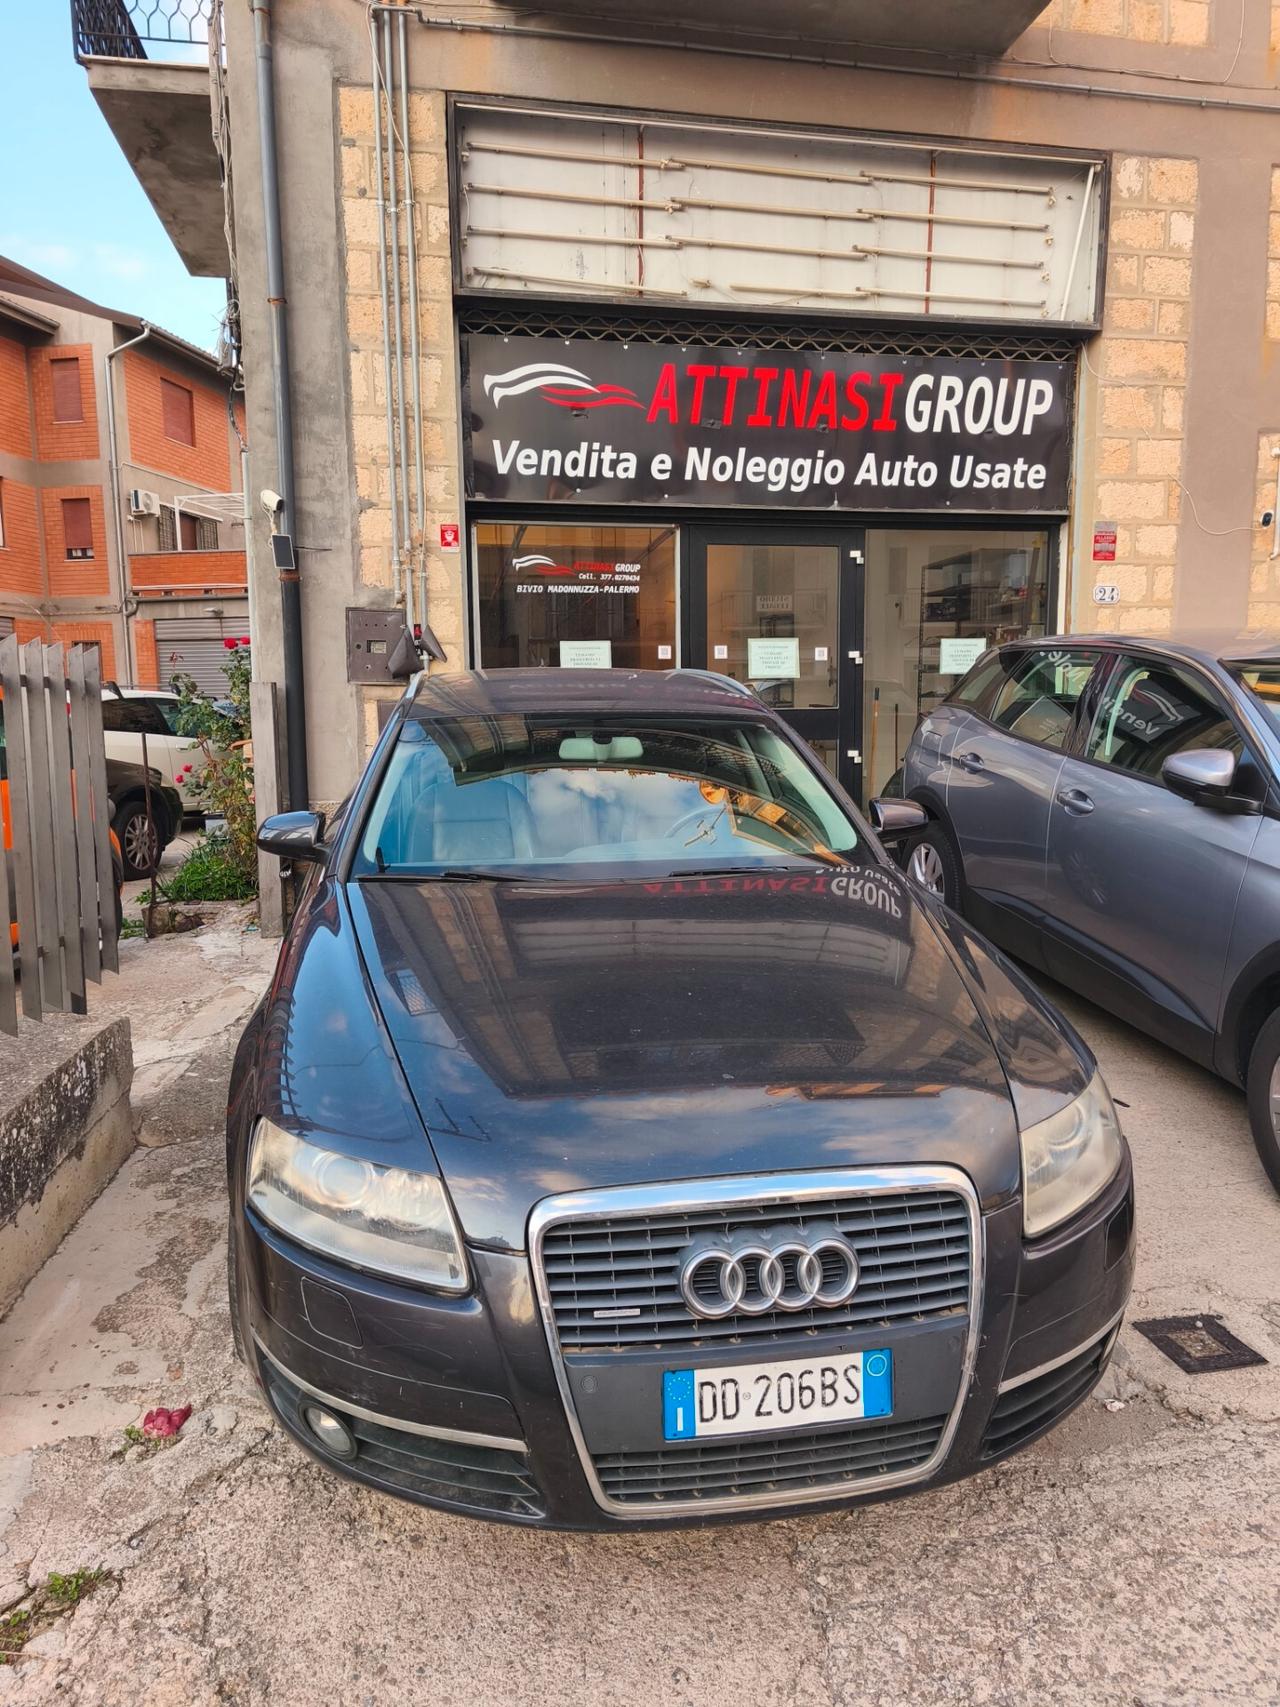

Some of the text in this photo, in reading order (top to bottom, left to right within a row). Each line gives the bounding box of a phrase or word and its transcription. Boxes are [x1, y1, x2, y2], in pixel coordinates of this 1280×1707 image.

[493, 440, 1047, 493] Vendita e Noleggio Auto Usate
[615, 563, 641, 573] GROUP
[516, 585, 543, 593] BIVIO
[1099, 587, 1115, 601] 24
